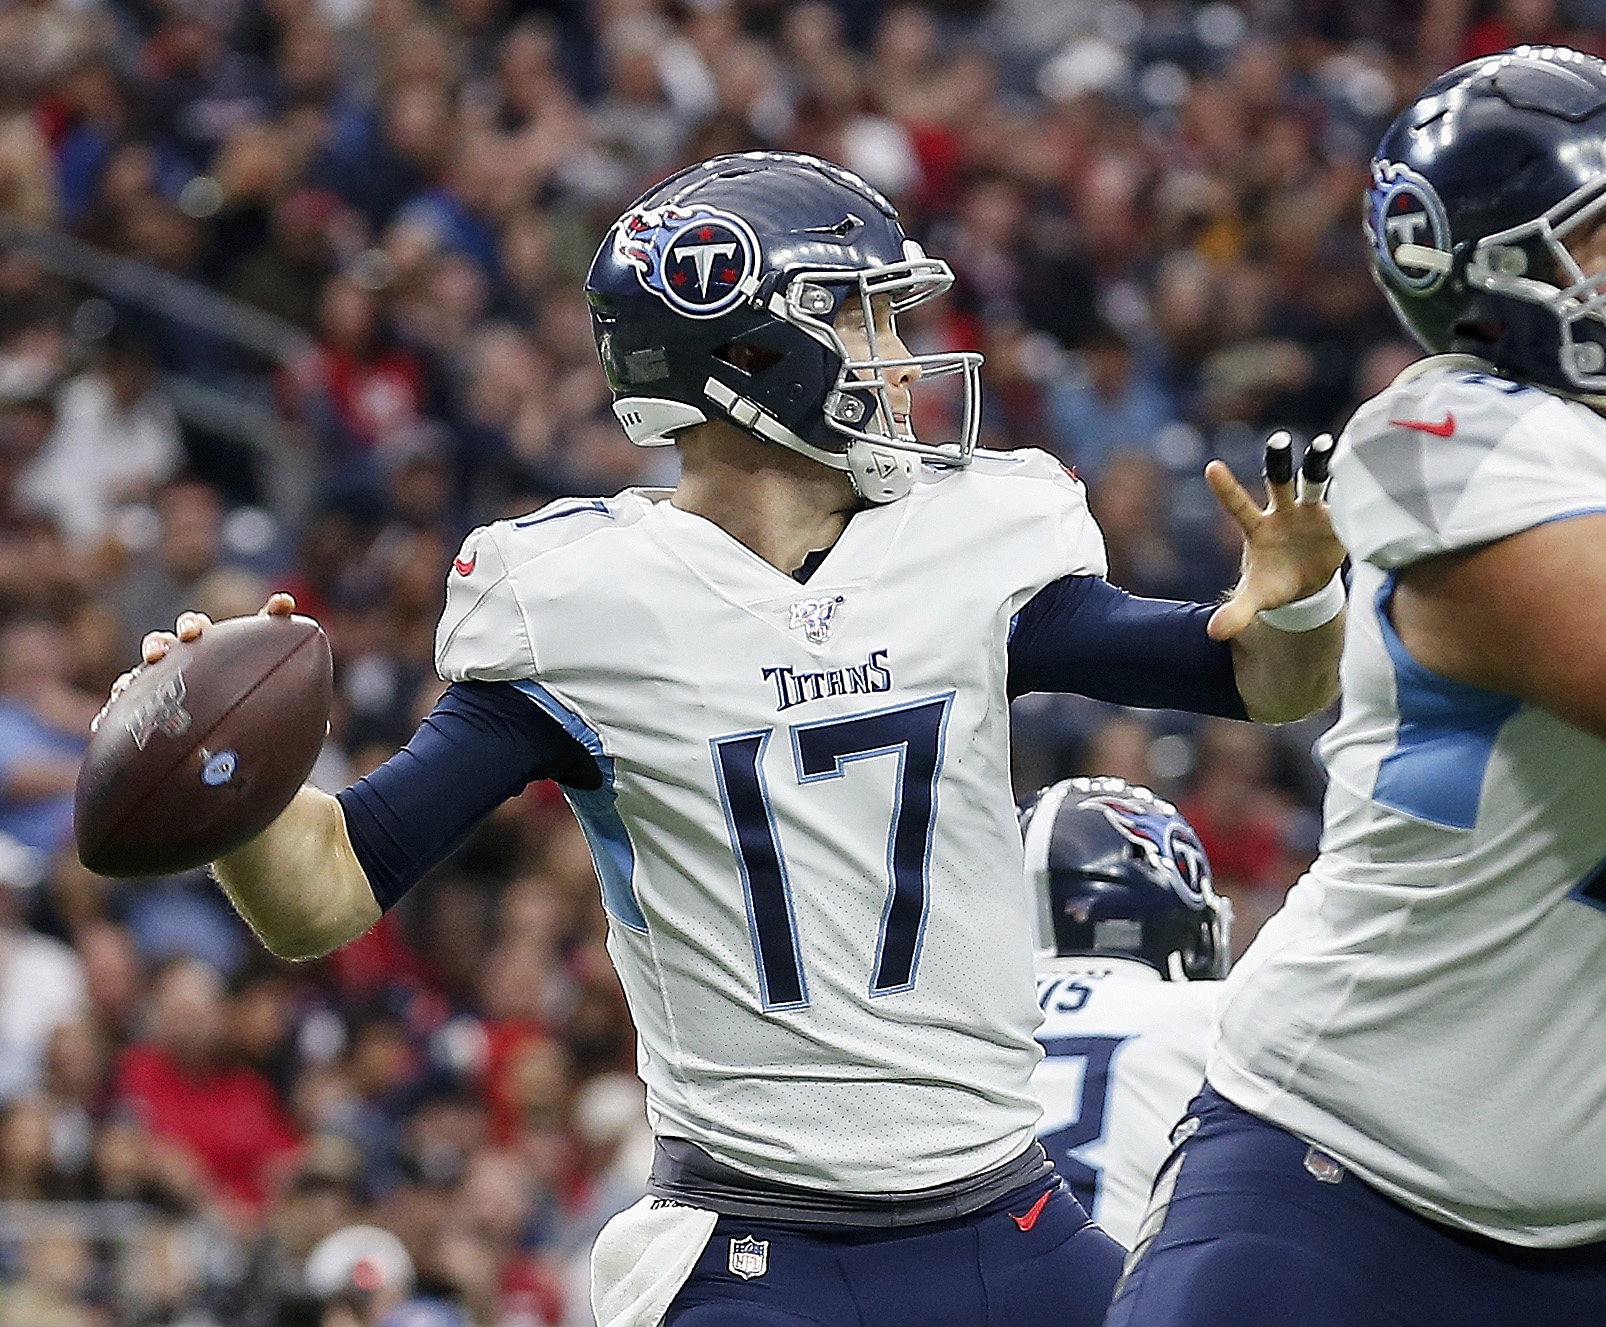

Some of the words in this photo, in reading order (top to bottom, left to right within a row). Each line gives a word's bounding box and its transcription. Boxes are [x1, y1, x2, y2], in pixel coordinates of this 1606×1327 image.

[673, 240, 738, 300] T
[761, 647, 891, 711] TITANS
[708, 689, 957, 1013] 17
